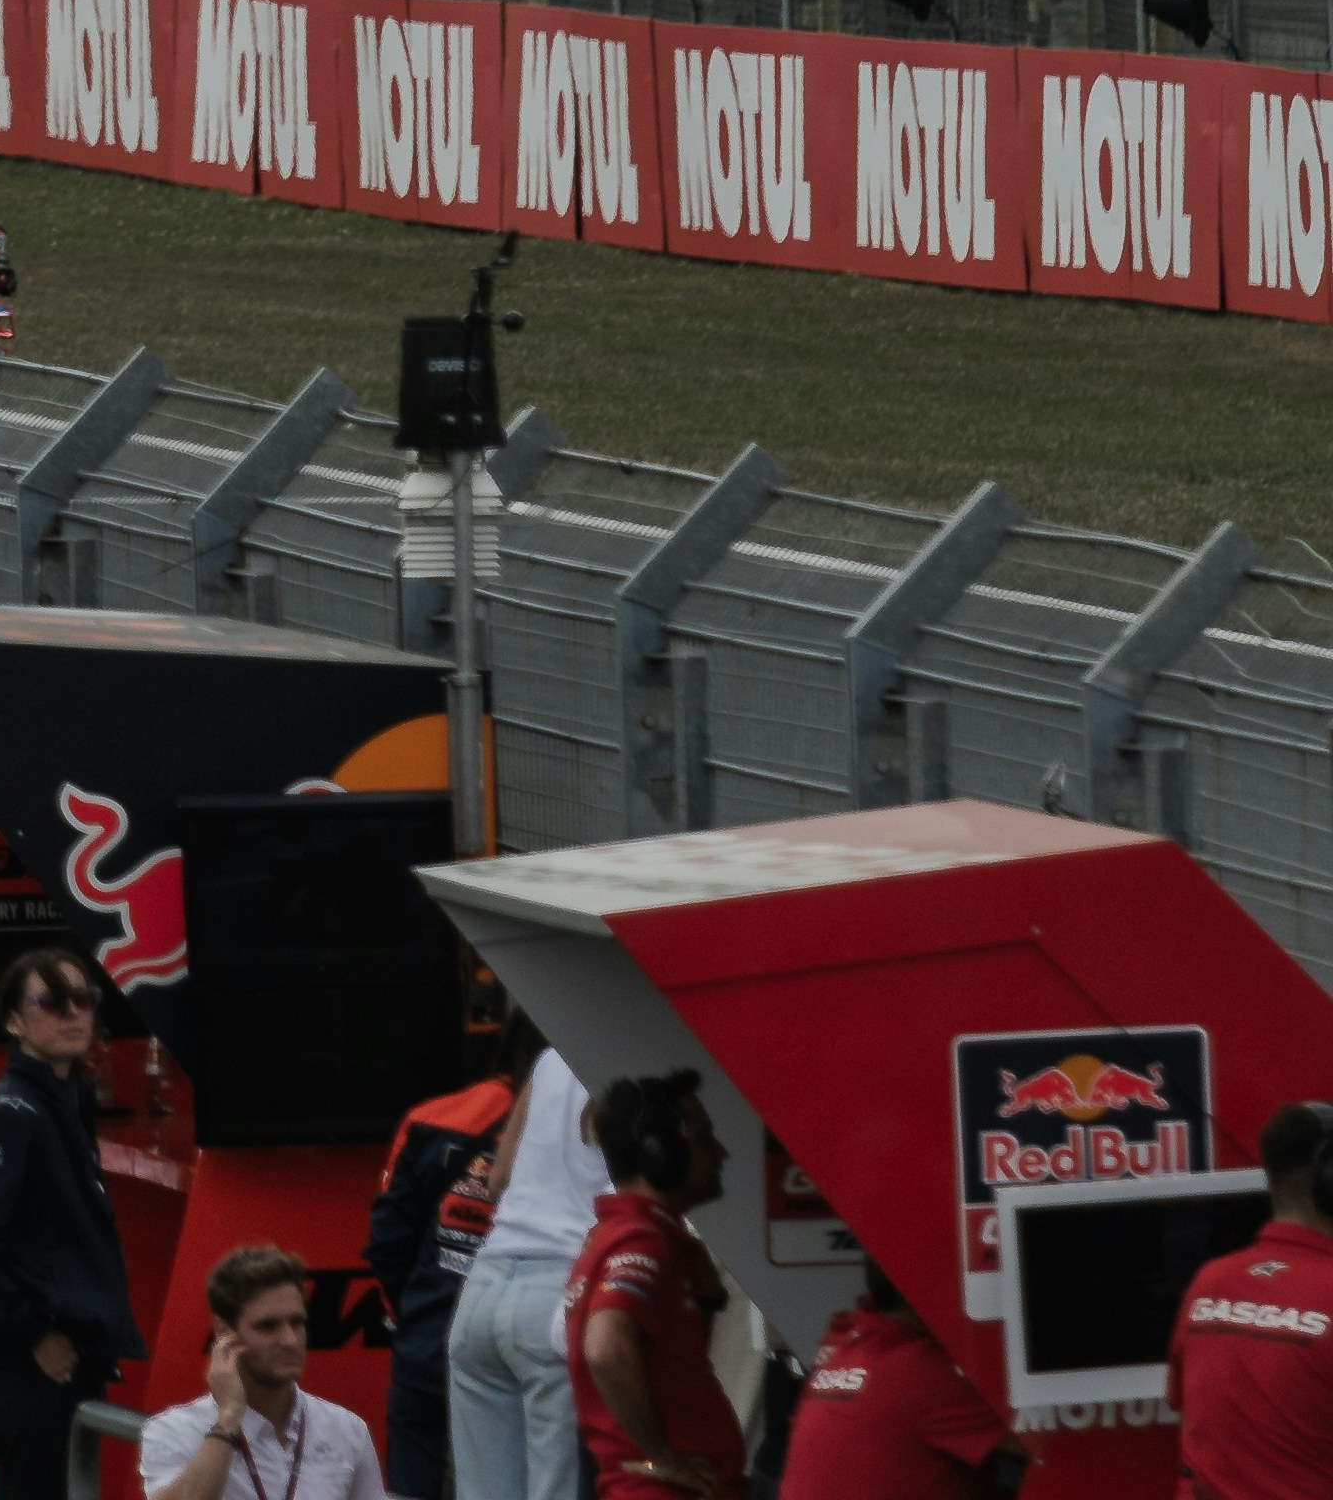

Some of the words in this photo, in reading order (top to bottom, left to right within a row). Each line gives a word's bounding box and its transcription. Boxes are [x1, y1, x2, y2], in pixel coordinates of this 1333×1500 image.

[354, 15, 481, 207] MOTUL
[516, 29, 639, 225] MOTUL
[674, 46, 812, 244] MOTUL
[856, 61, 996, 263] MOTUL
[1040, 73, 1192, 280] MOTUL
[24, 901, 63, 920] RAC
[982, 1124, 1083, 1184] Red
[1091, 1121, 1190, 1180] Bull
[1189, 1297, 1332, 1336] GASGAS
[1011, 1398, 1182, 1434] MOTUL
